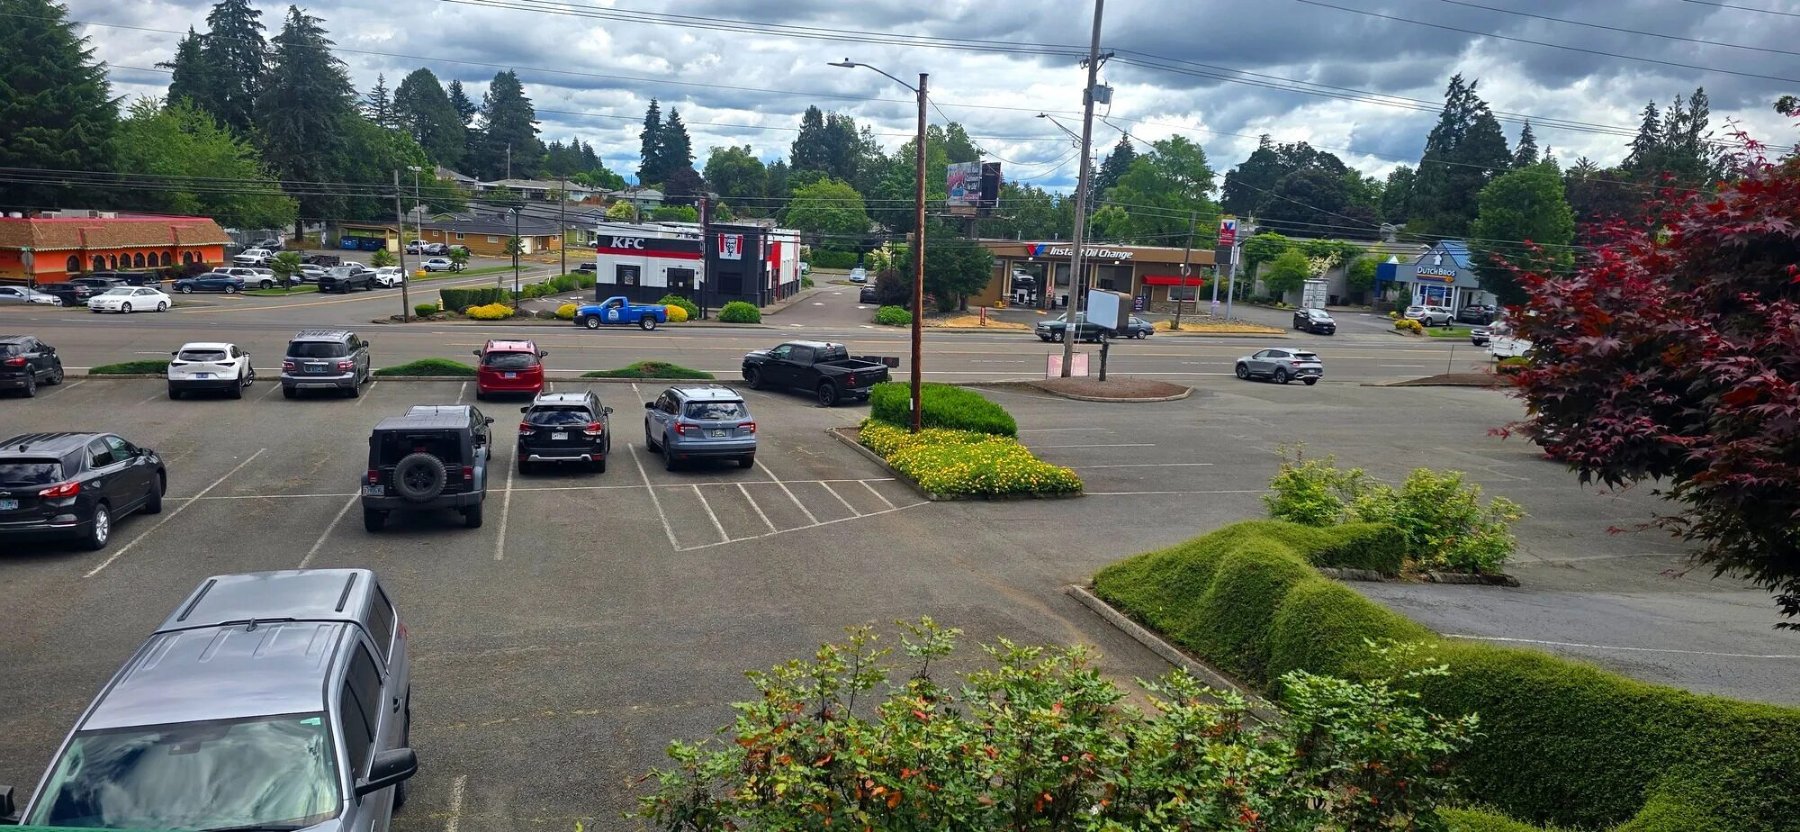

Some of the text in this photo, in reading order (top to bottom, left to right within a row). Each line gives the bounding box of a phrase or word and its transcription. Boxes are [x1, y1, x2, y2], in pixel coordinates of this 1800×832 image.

[610, 237, 645, 249] KFC
[1050, 246, 1084, 256] Instat
[1085, 248, 1098, 256] Oil
[1098, 249, 1134, 260] Change
